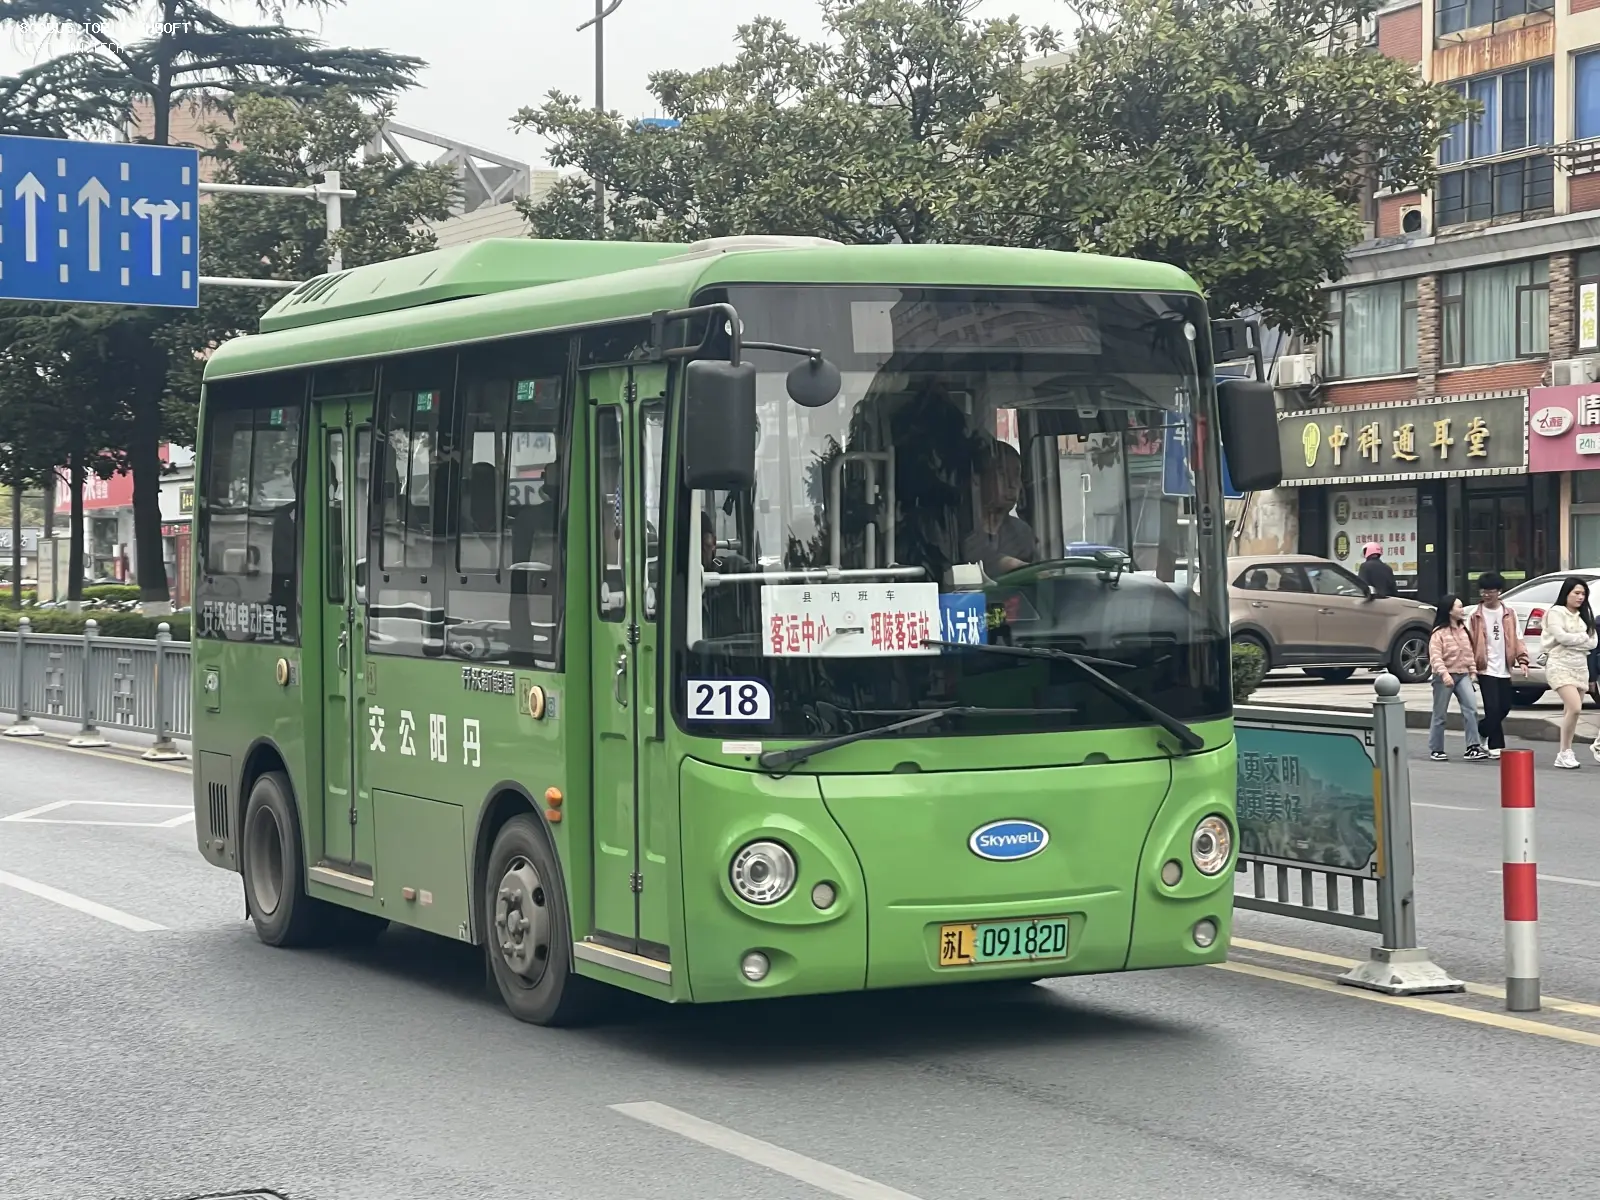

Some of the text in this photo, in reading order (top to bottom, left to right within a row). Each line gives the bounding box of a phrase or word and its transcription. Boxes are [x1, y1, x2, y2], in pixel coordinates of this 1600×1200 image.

[1582, 290, 1596, 339] 宾馆
[1328, 416, 1490, 466] 中科通耳堂
[802, 590, 896, 603] 县内班车
[770, 610, 931, 655] 客运中心 珥陵客运站
[696, 684, 758, 715] 218
[1237, 751, 1300, 786] 更文明
[943, 923, 1067, 960] 苏L 09182D
